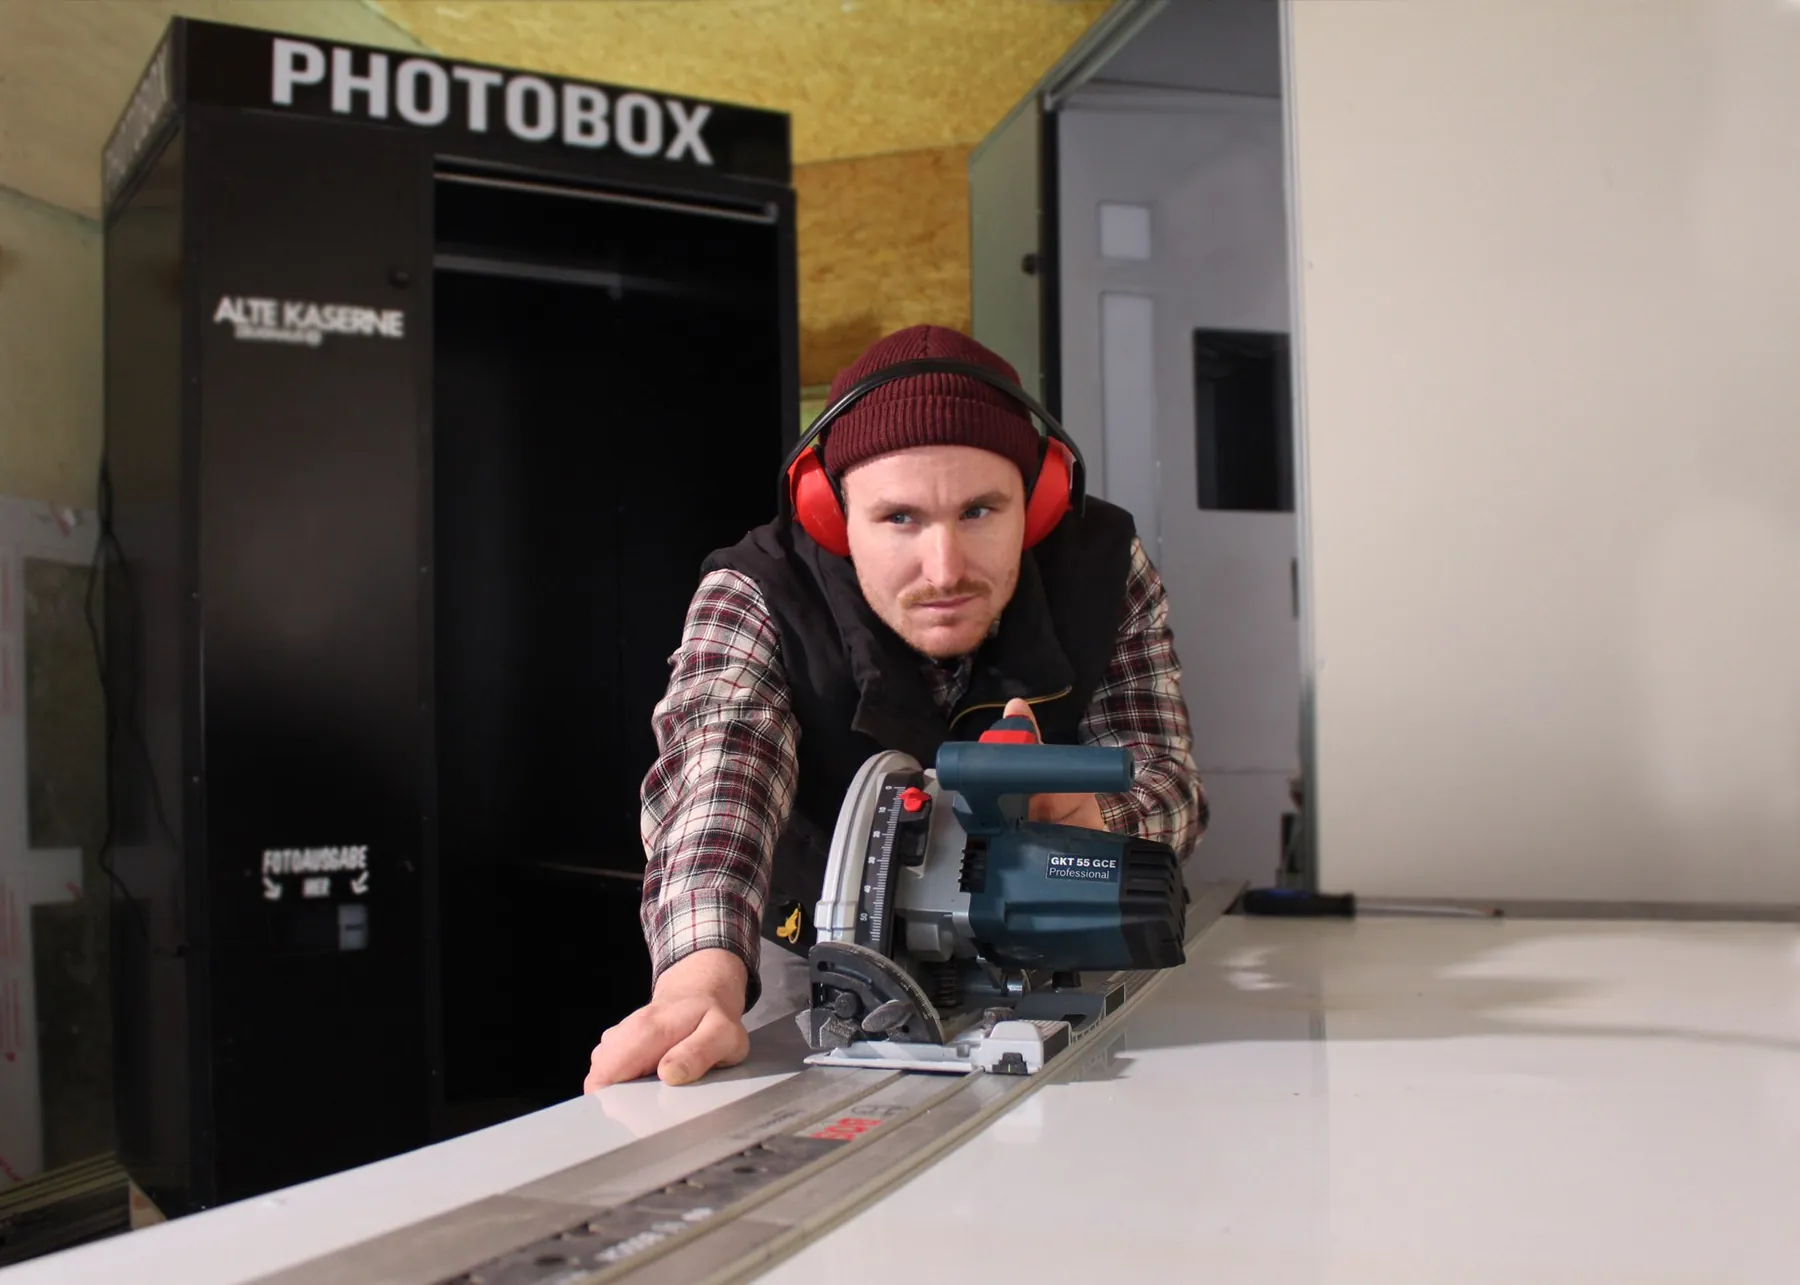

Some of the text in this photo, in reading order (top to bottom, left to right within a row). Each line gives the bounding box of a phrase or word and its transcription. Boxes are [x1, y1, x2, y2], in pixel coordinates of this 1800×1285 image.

[271, 38, 714, 165] PHOTOBOX
[213, 296, 277, 326] ALTE
[282, 301, 404, 339] KASERNE
[1050, 856, 1116, 868] GKT 55 GCE
[1049, 867, 1110, 879] Professional
[859, 912, 868, 922] 50
